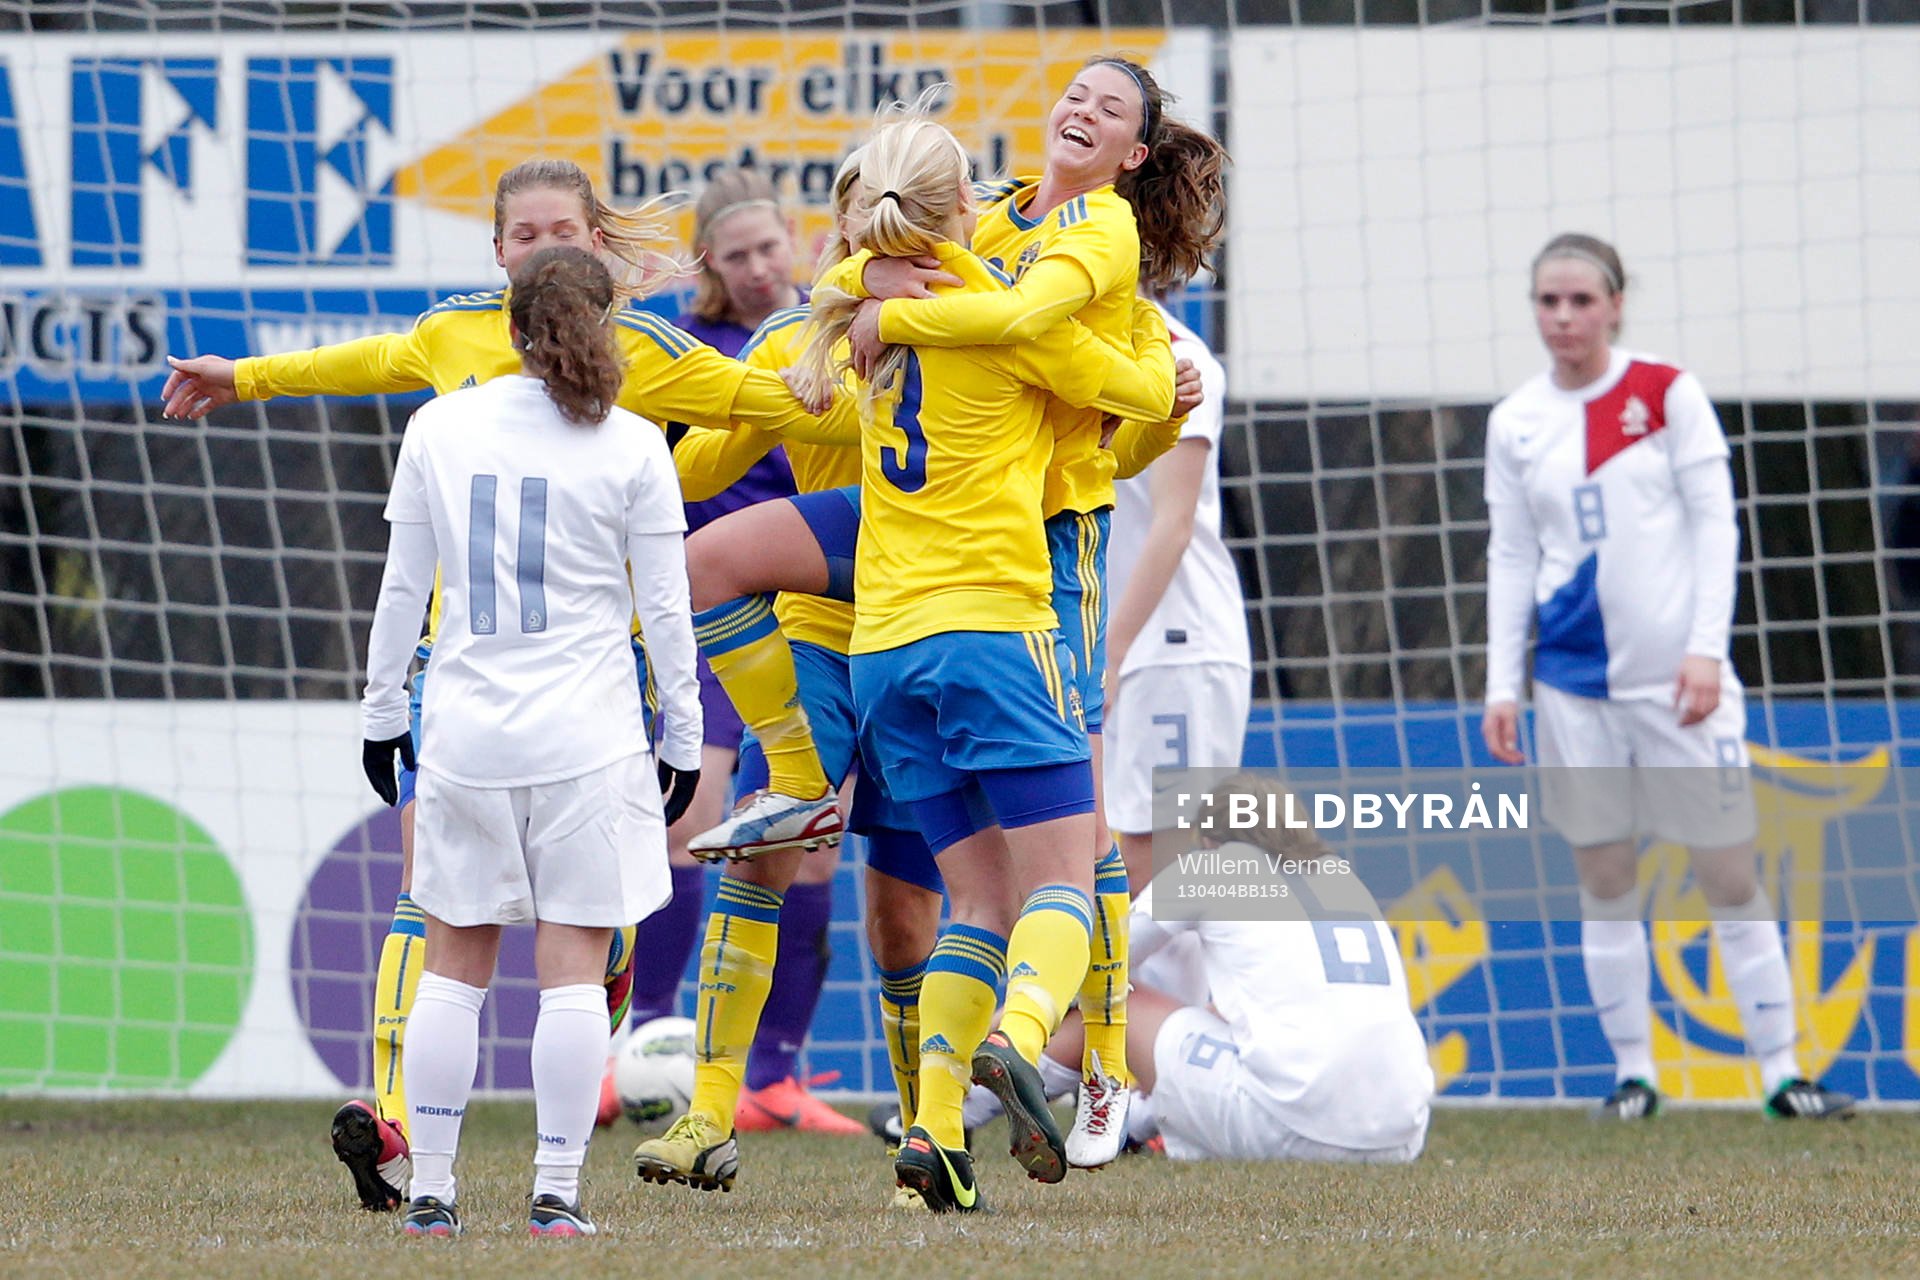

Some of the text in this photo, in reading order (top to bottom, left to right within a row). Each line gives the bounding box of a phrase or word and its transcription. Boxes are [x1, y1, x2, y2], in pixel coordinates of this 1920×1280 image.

[608, 43, 948, 114] Voor elke
[879, 345, 929, 493] 3
[1573, 484, 1606, 542] 8
[468, 474, 548, 635] 11
[1152, 713, 1188, 774] 3
[1716, 738, 1743, 792] 8
[1278, 864, 1391, 986] 6
